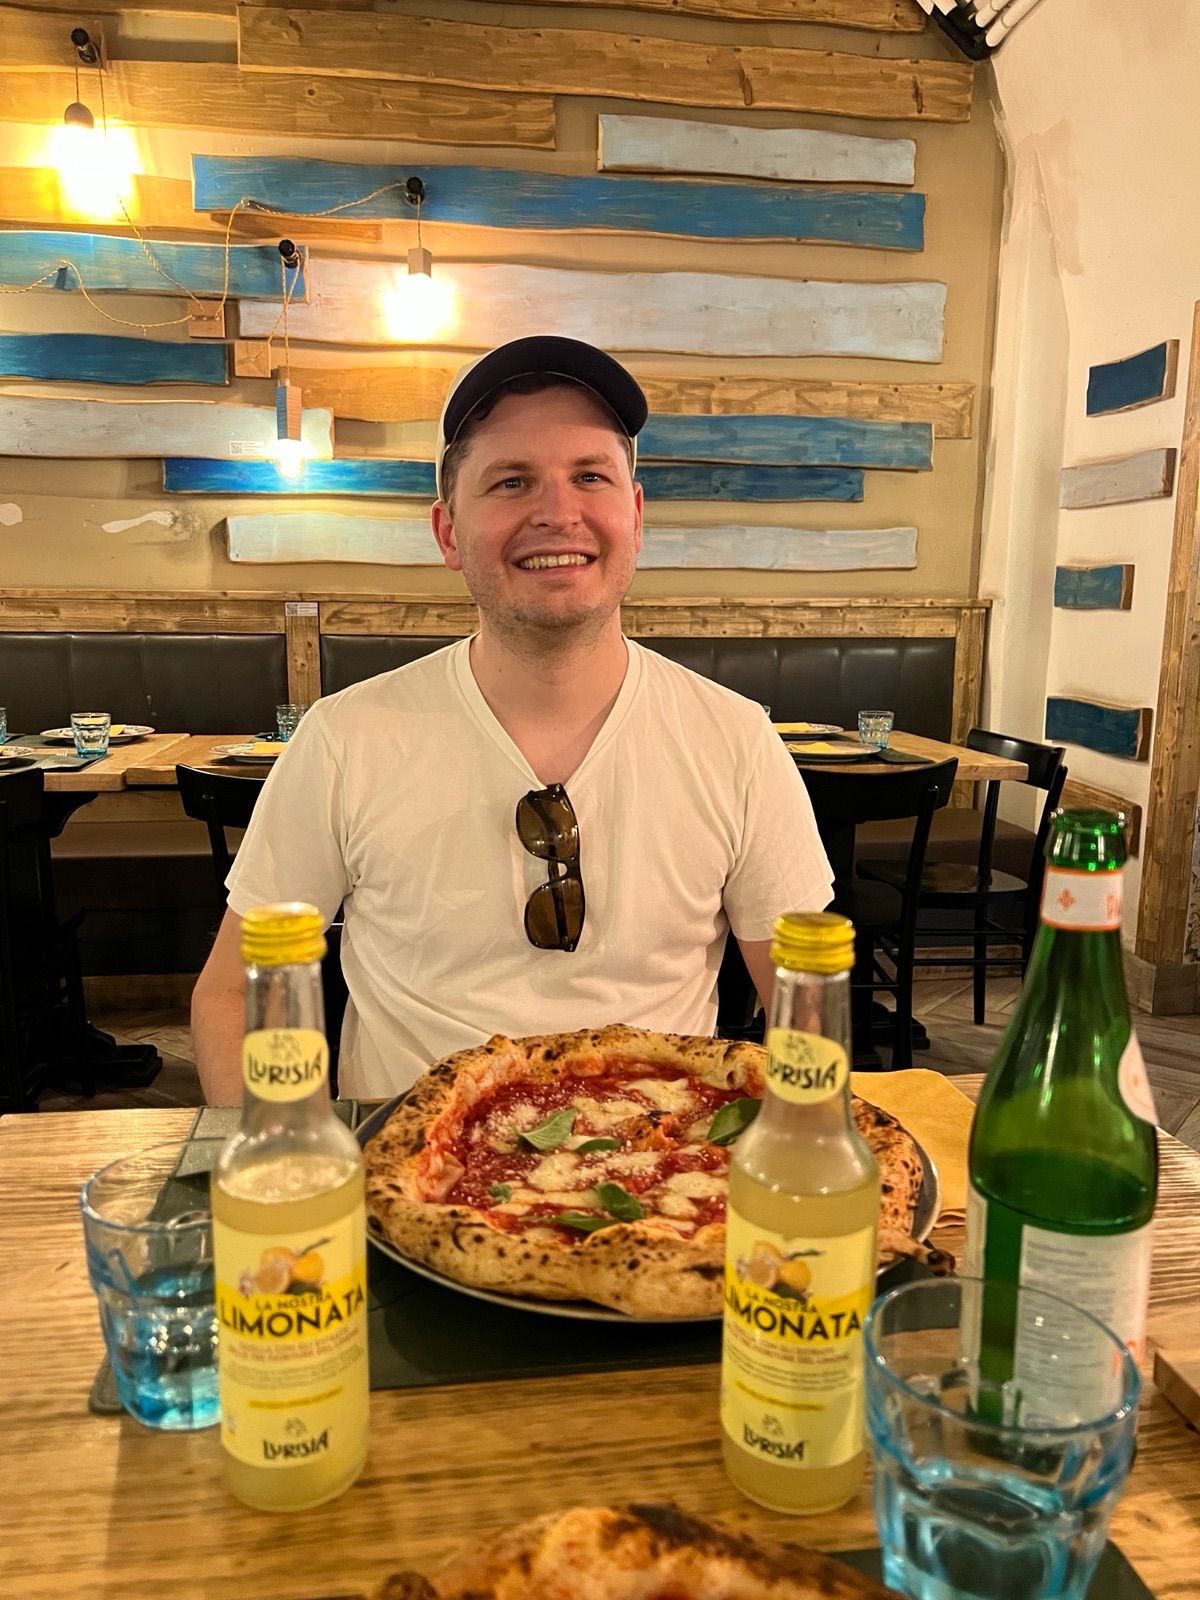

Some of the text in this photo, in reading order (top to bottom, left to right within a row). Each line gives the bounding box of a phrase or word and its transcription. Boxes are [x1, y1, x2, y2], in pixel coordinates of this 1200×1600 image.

[249, 1048, 322, 1085] LURISIA
[219, 1281, 365, 1338] LIMONATA
[255, 1290, 332, 1311] LA NOSTRA
[745, 1286, 818, 1314] LA NOSTRA
[743, 1422, 806, 1461] LURISIA
